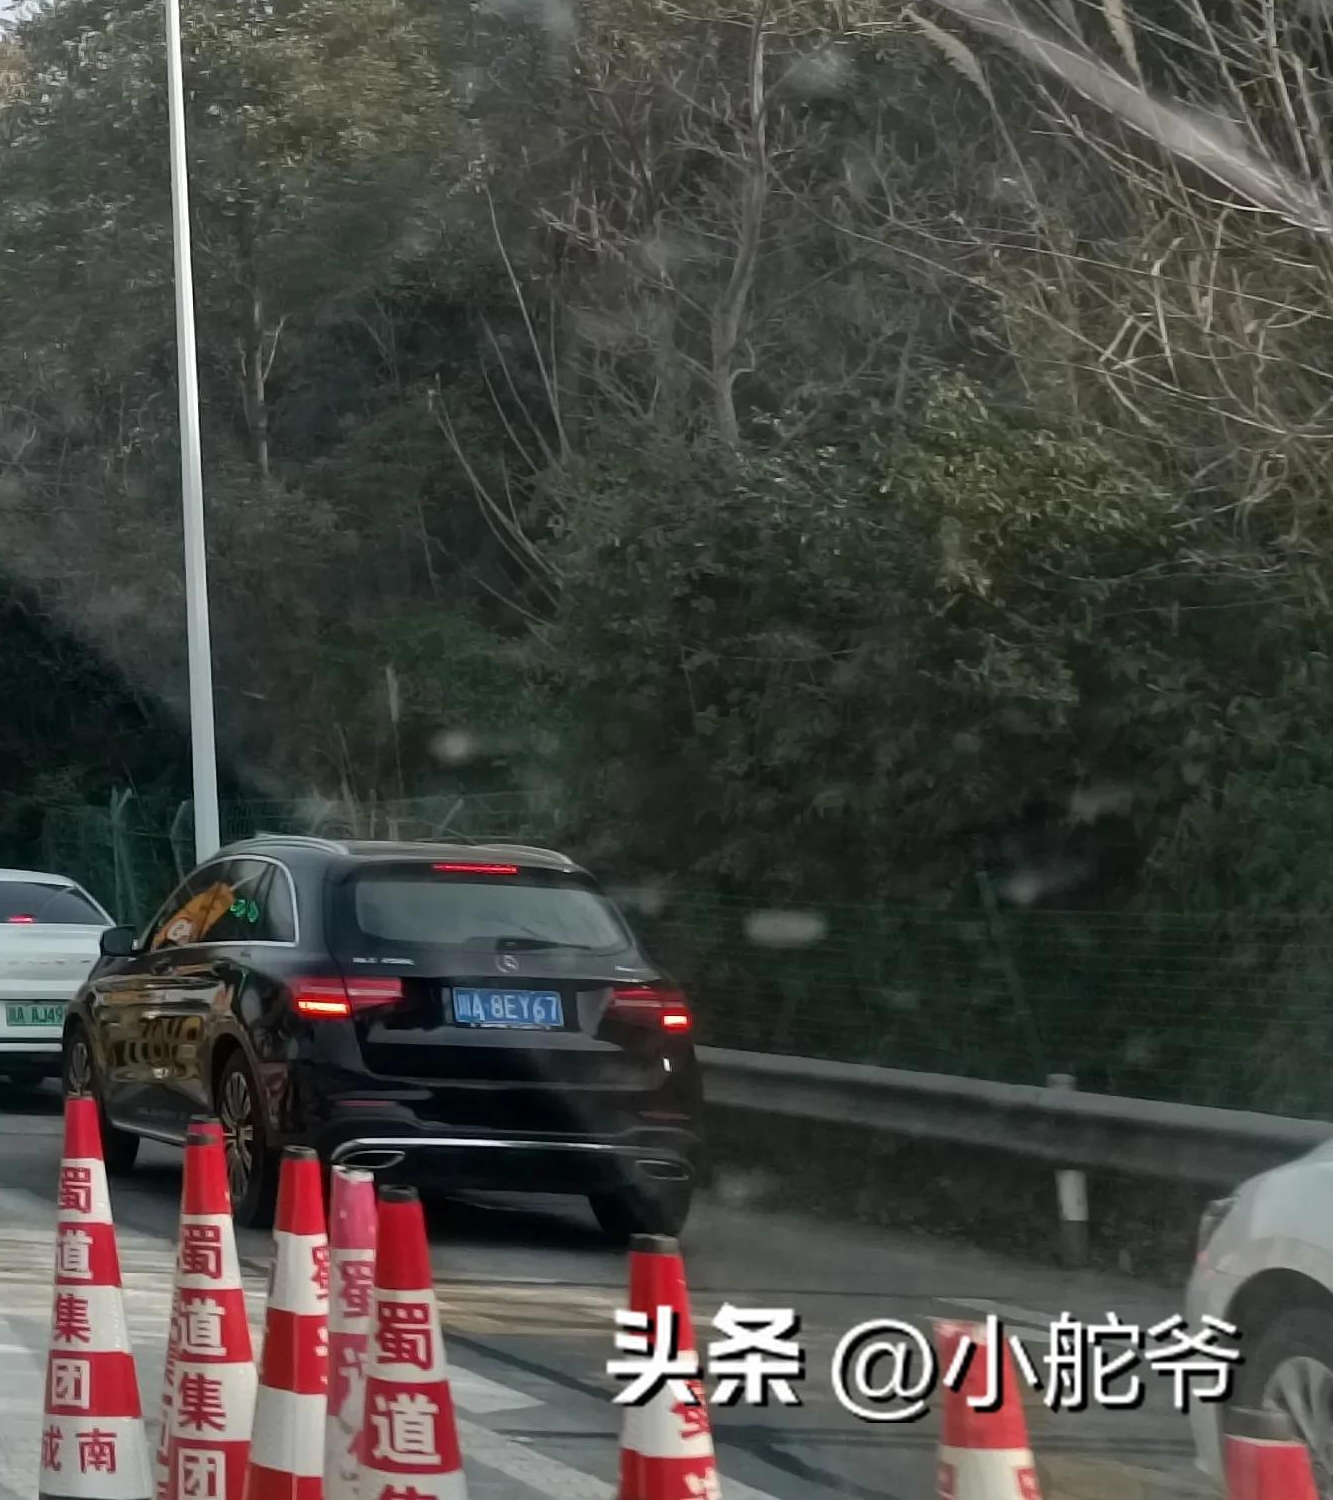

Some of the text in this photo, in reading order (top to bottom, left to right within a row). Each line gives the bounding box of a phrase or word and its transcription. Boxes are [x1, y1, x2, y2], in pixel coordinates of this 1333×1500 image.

[52, 1165, 94, 1411] 蜀道集团
[370, 1301, 443, 1500] 蜀道
